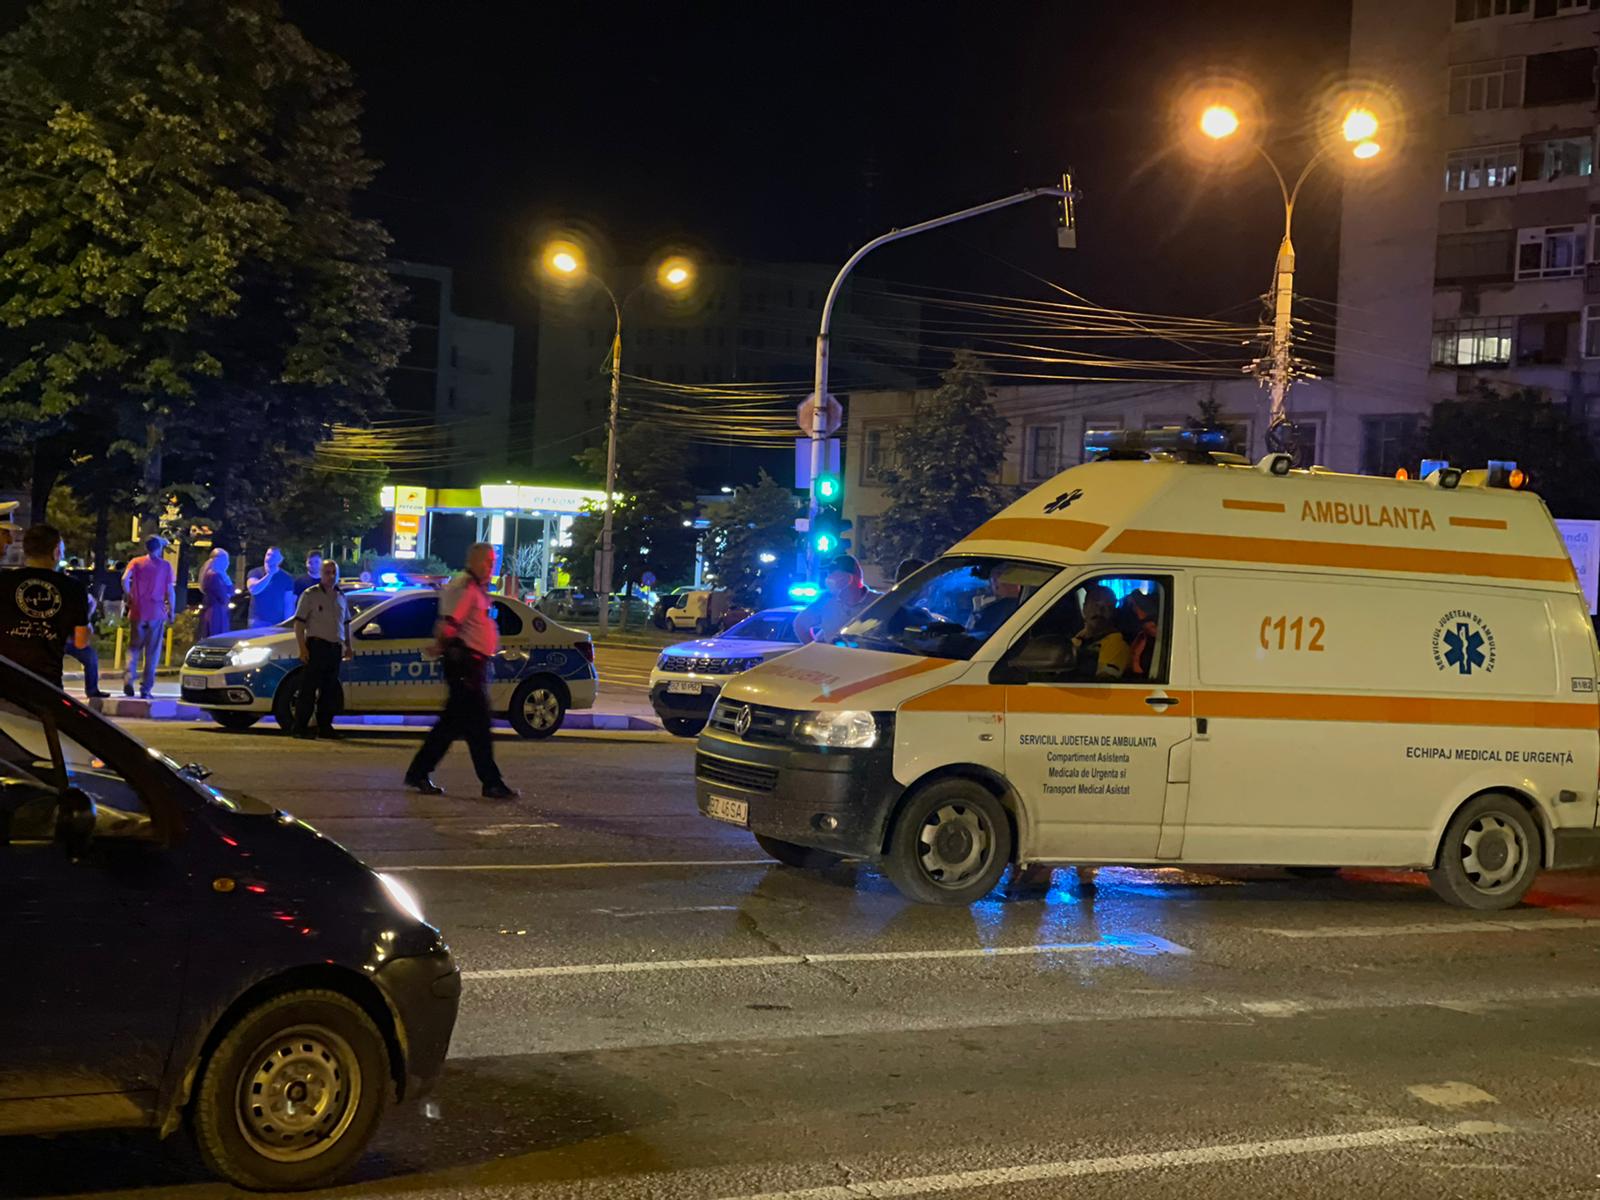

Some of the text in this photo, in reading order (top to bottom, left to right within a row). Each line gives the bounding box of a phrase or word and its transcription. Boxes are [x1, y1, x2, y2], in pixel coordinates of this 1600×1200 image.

[1301, 500, 1437, 531] AMBULANTA
[1273, 615, 1325, 651] 112
[1432, 609, 1496, 673] SERVICIUL JUDETEAN DE AMBULANTA
[391, 661, 441, 677] POL
[1019, 734, 1157, 748] SERVICIUL JUDETEAN DE AMBULANTA
[1047, 751, 1130, 764] Compartiment Asistenta
[1406, 746, 1452, 760] ECHIPAJ
[1455, 748, 1503, 762] MEDICAL
[1505, 751, 1520, 762] DE
[1048, 767, 1127, 781] Medicala de Urgenta si
[1043, 783, 1130, 796] Transport Medical Asistat
